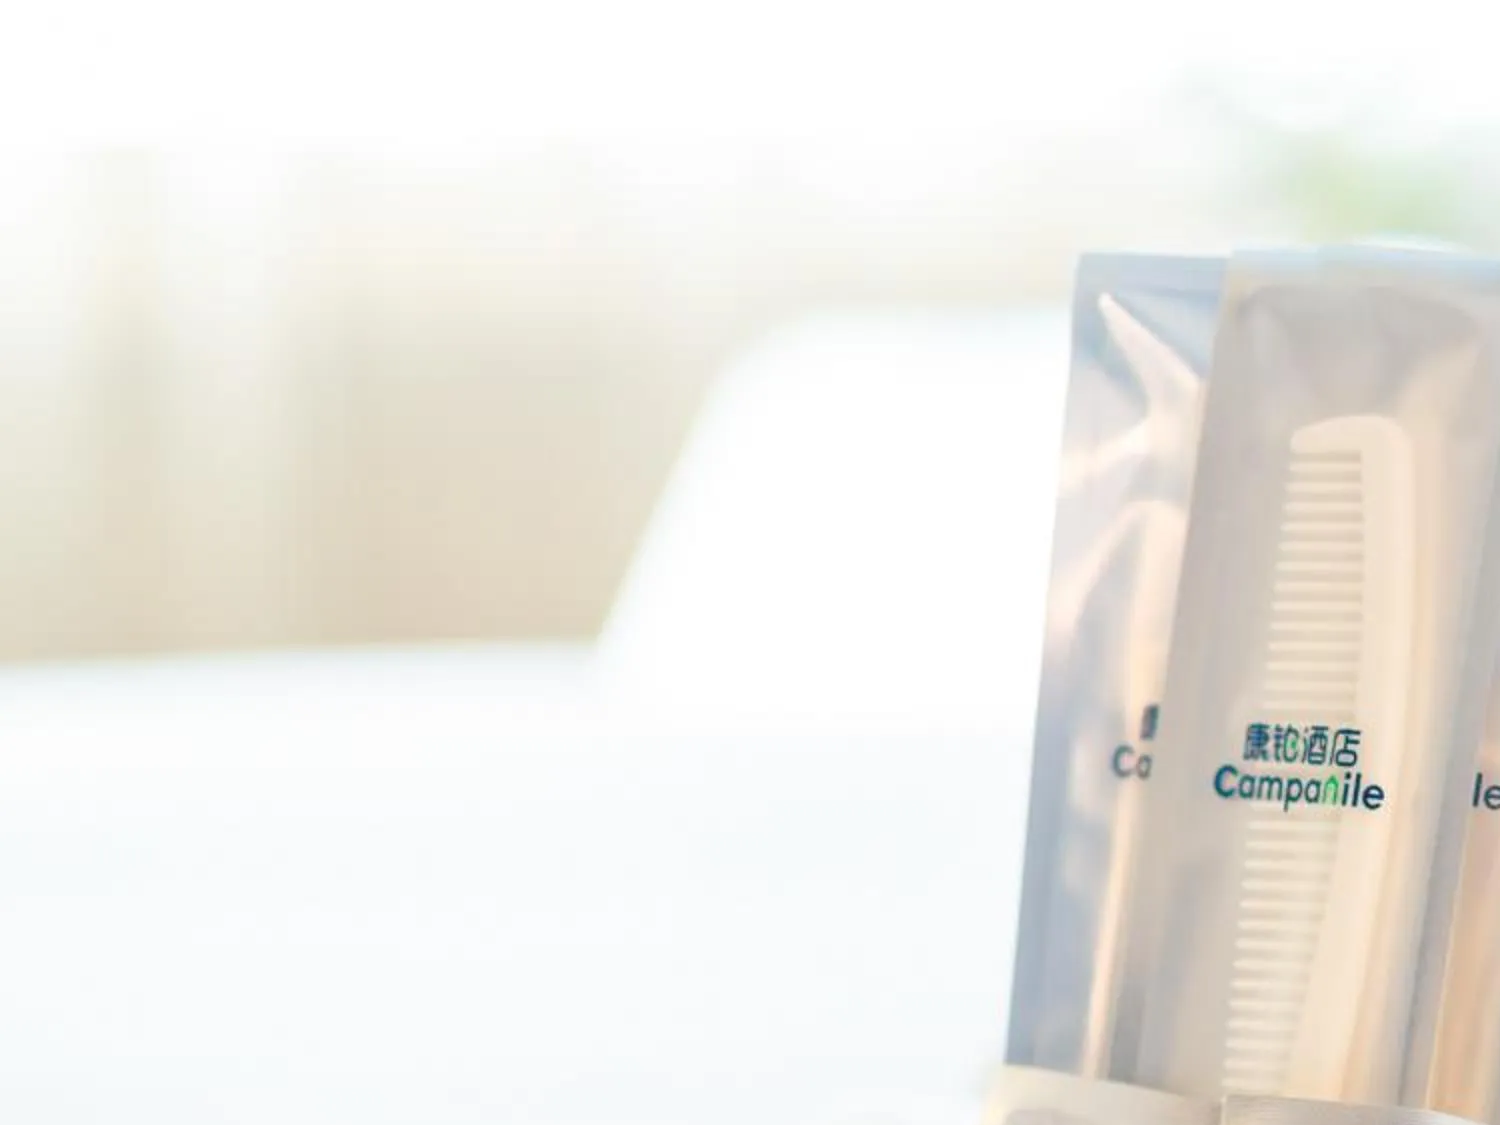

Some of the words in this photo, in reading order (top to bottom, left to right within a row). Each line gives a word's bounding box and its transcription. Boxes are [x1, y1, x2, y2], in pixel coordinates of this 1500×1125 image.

[1243, 723, 1361, 766] 康铂酒店
[1213, 764, 1385, 813] Campanile
